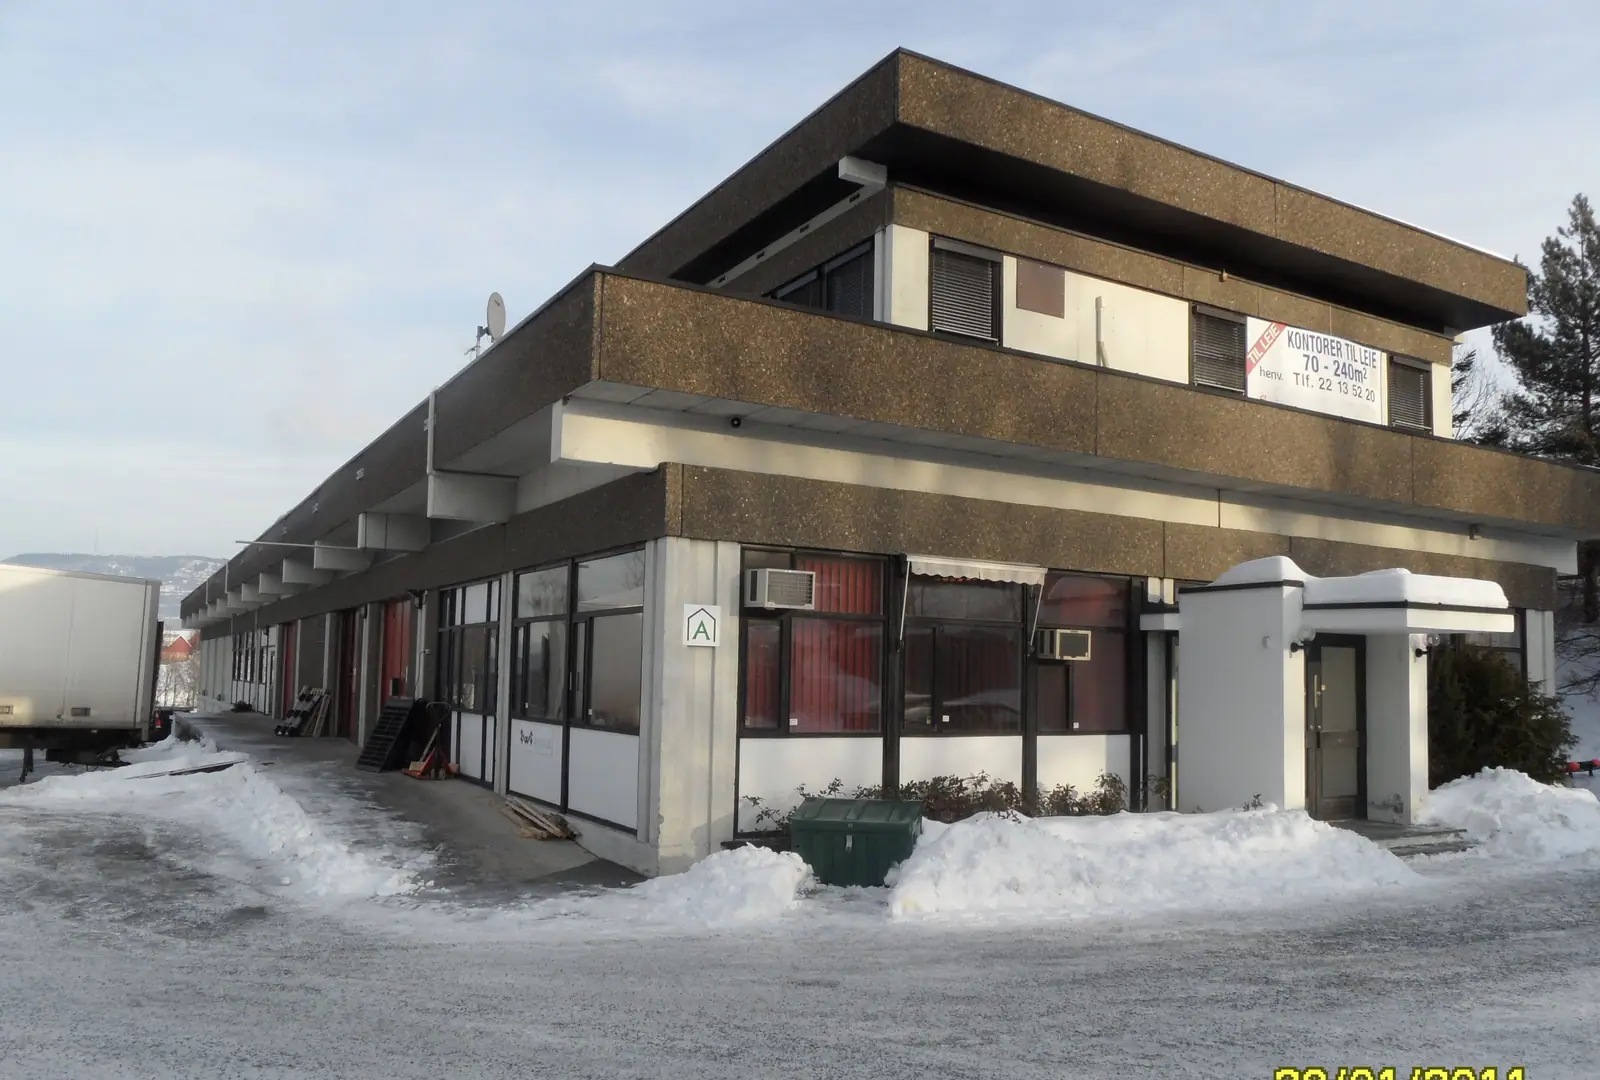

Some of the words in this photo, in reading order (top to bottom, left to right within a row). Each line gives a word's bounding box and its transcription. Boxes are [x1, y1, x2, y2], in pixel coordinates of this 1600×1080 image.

[1247, 347, 1264, 365] TIL
[1260, 324, 1280, 350] LEIE
[1287, 329, 1343, 358] KONTORER
[1345, 343, 1358, 363] TIL
[1359, 347, 1377, 369] LEIE
[1302, 354, 1320, 373] 70
[1259, 366, 1284, 381] henv.
[1293, 372, 1315, 389] Tlf.
[1318, 377, 1333, 391] 22
[1338, 381, 1349, 395] 13
[1352, 384, 1363, 398] 52
[1365, 389, 1376, 403] 20
[692, 620, 711, 640] A
